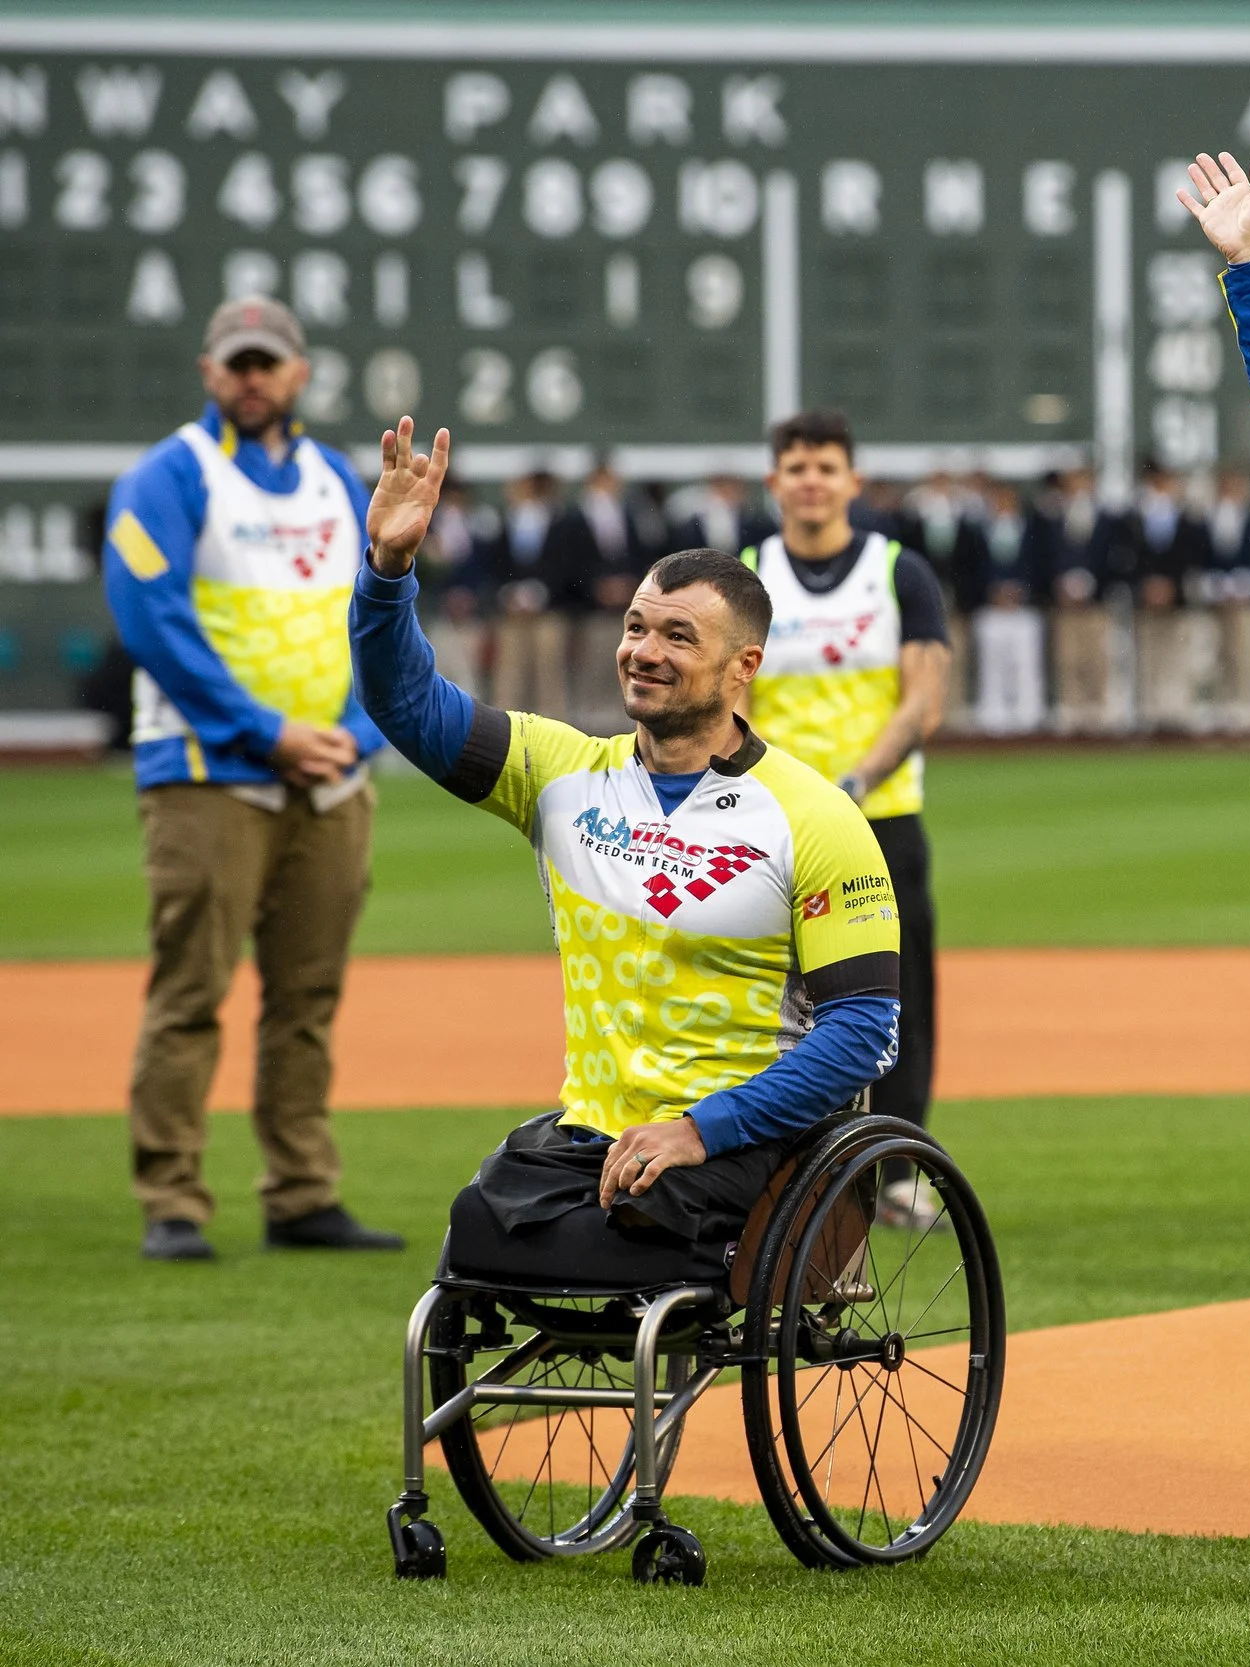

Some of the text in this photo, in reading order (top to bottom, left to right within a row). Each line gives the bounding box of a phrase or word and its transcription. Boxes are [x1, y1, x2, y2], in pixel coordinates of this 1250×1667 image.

[443, 70, 788, 147] PARK
[54, 149, 111, 233] 2
[128, 149, 188, 235] 3
[218, 151, 280, 233] 4
[293, 152, 352, 236] 5
[357, 154, 423, 238] 6
[453, 154, 508, 236] 7
[523, 156, 585, 239] 8
[588, 156, 653, 239] 9
[678, 158, 760, 240] 10
[819, 157, 884, 237] R
[1021, 158, 1078, 238] E
[572, 806, 707, 867] Achilles
[580, 833, 695, 879] FREEDOM TEAM
[842, 874, 890, 895] Military
